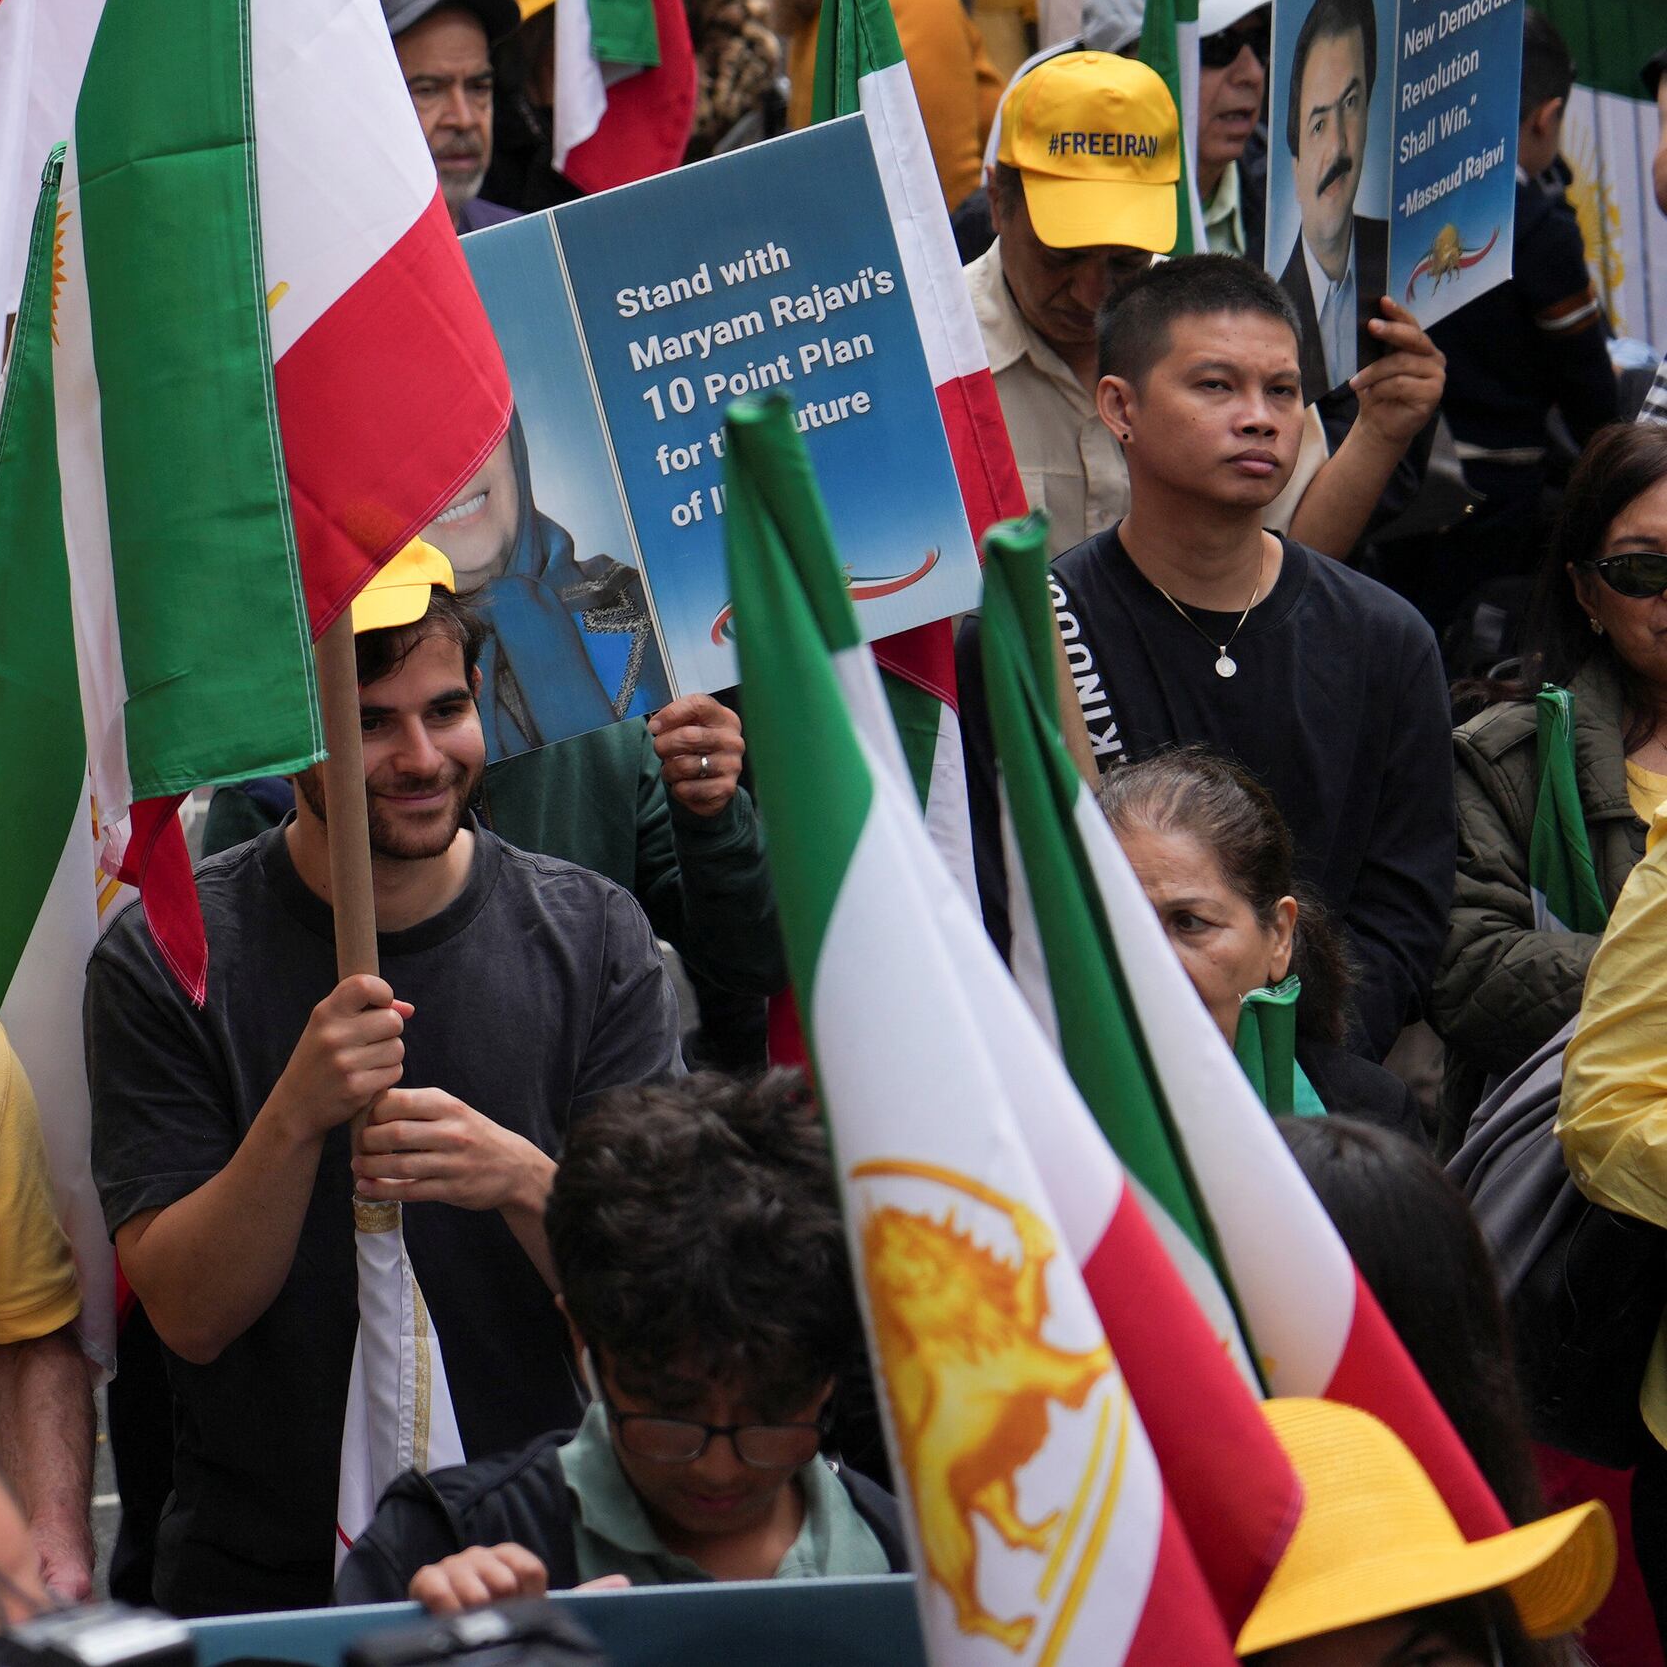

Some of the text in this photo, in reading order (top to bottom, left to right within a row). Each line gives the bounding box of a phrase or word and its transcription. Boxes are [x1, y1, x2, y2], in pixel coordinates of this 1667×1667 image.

[1404, 25, 1436, 59] New
[1402, 48, 1480, 113] Revolution
[1048, 132, 1158, 159] #FREEIRAN
[1398, 137, 1506, 219] -Massoud Rajavi
[1400, 120, 1437, 165] Shall
[616, 242, 791, 319] Stand with
[629, 266, 895, 372] Maryam Rajavi's
[642, 333, 874, 422] 10 Point Plan
[655, 436, 703, 476] for
[789, 390, 871, 433] uture
[670, 491, 704, 528] of
